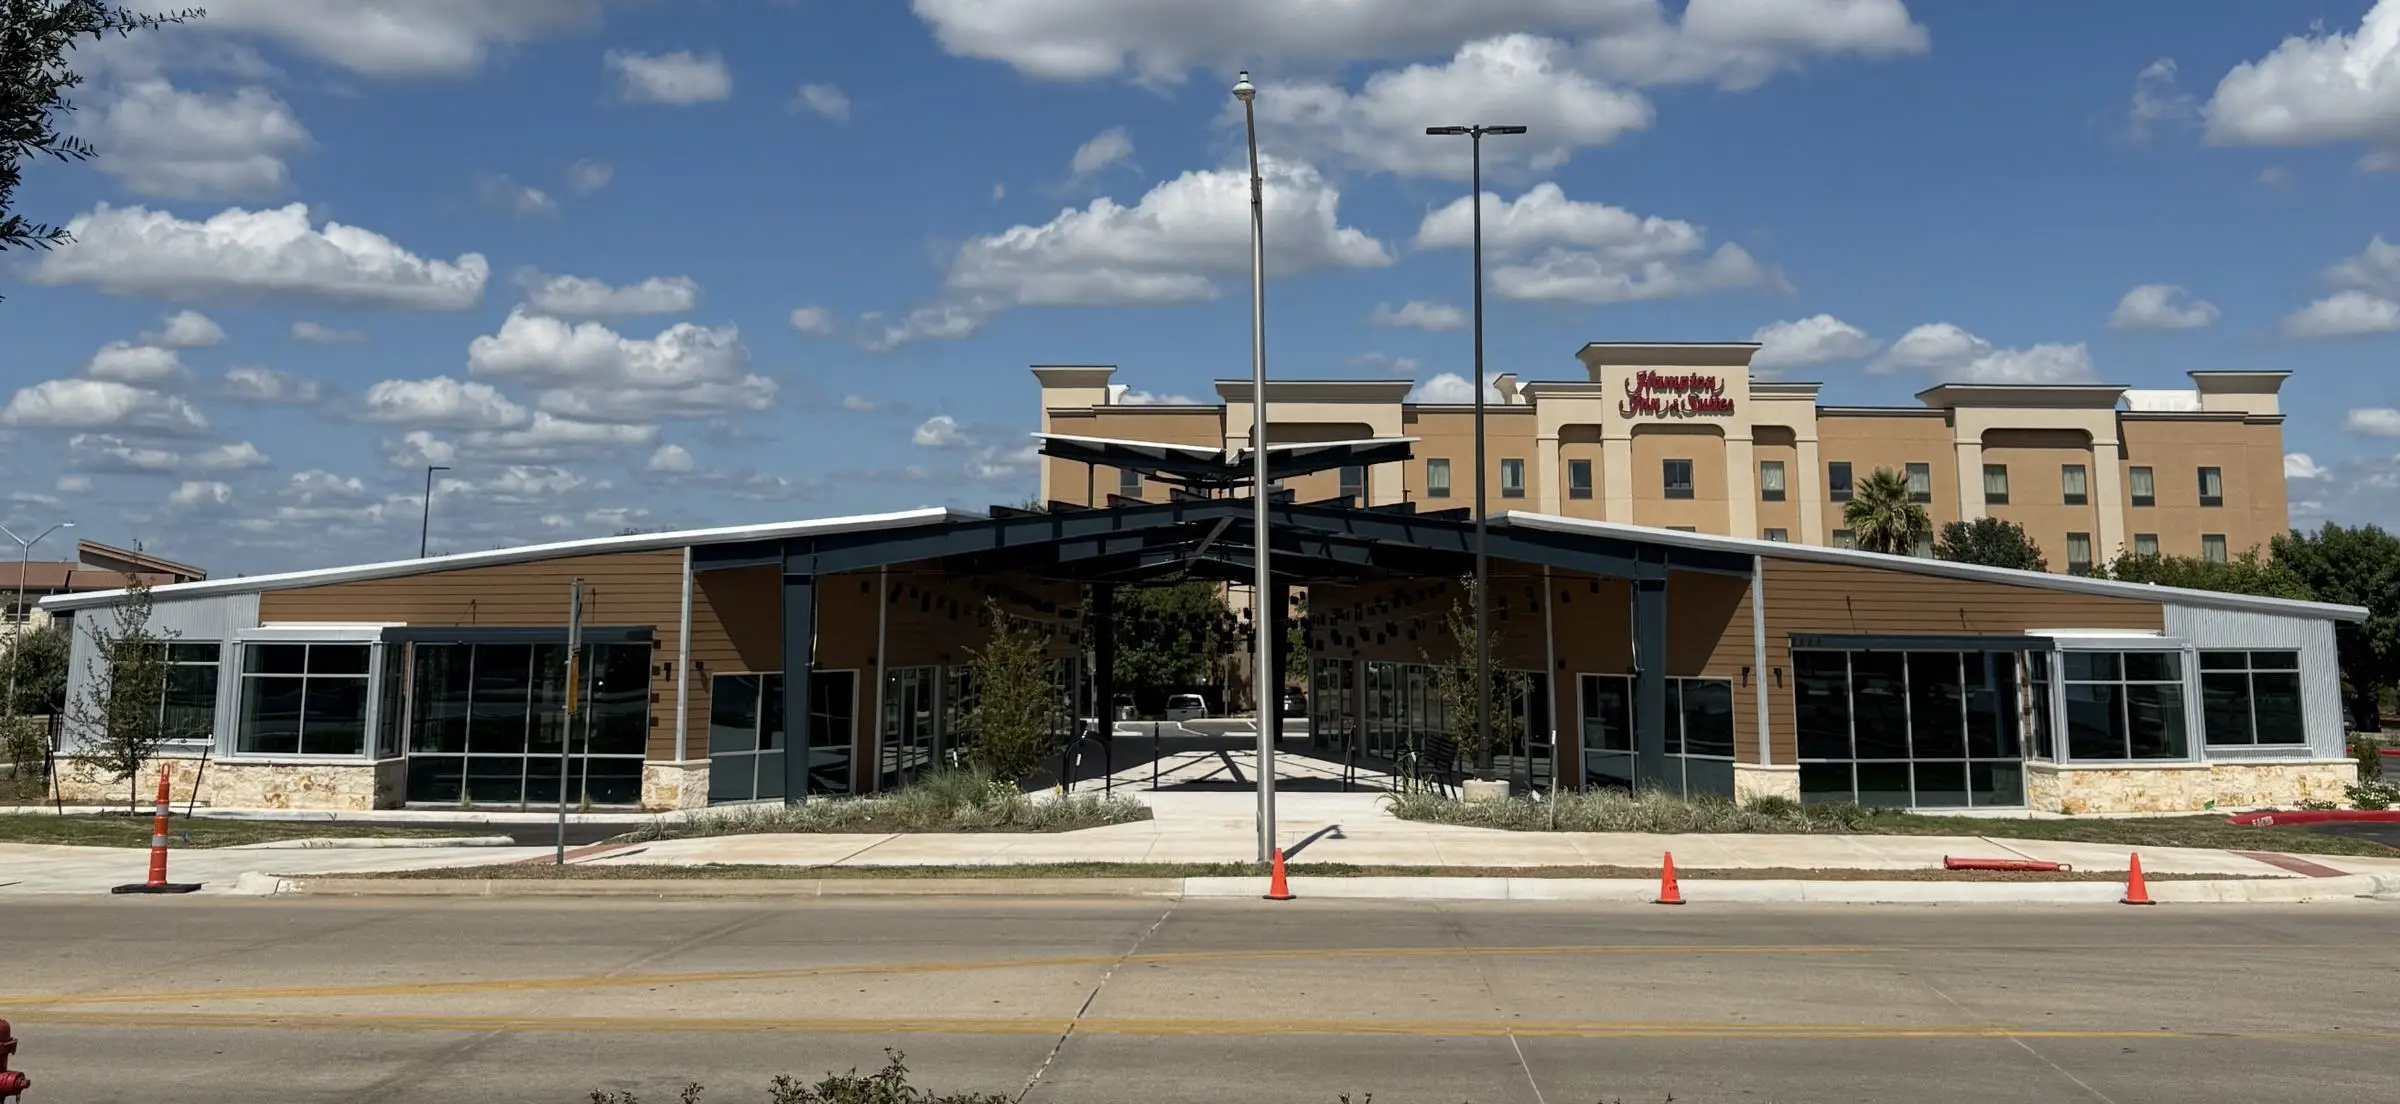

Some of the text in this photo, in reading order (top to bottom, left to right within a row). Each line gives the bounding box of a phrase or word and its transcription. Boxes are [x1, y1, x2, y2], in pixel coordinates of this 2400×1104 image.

[1625, 370, 1724, 398] Hampton
[1619, 397, 1669, 419] Inn
[1682, 393, 1735, 417] Suites
